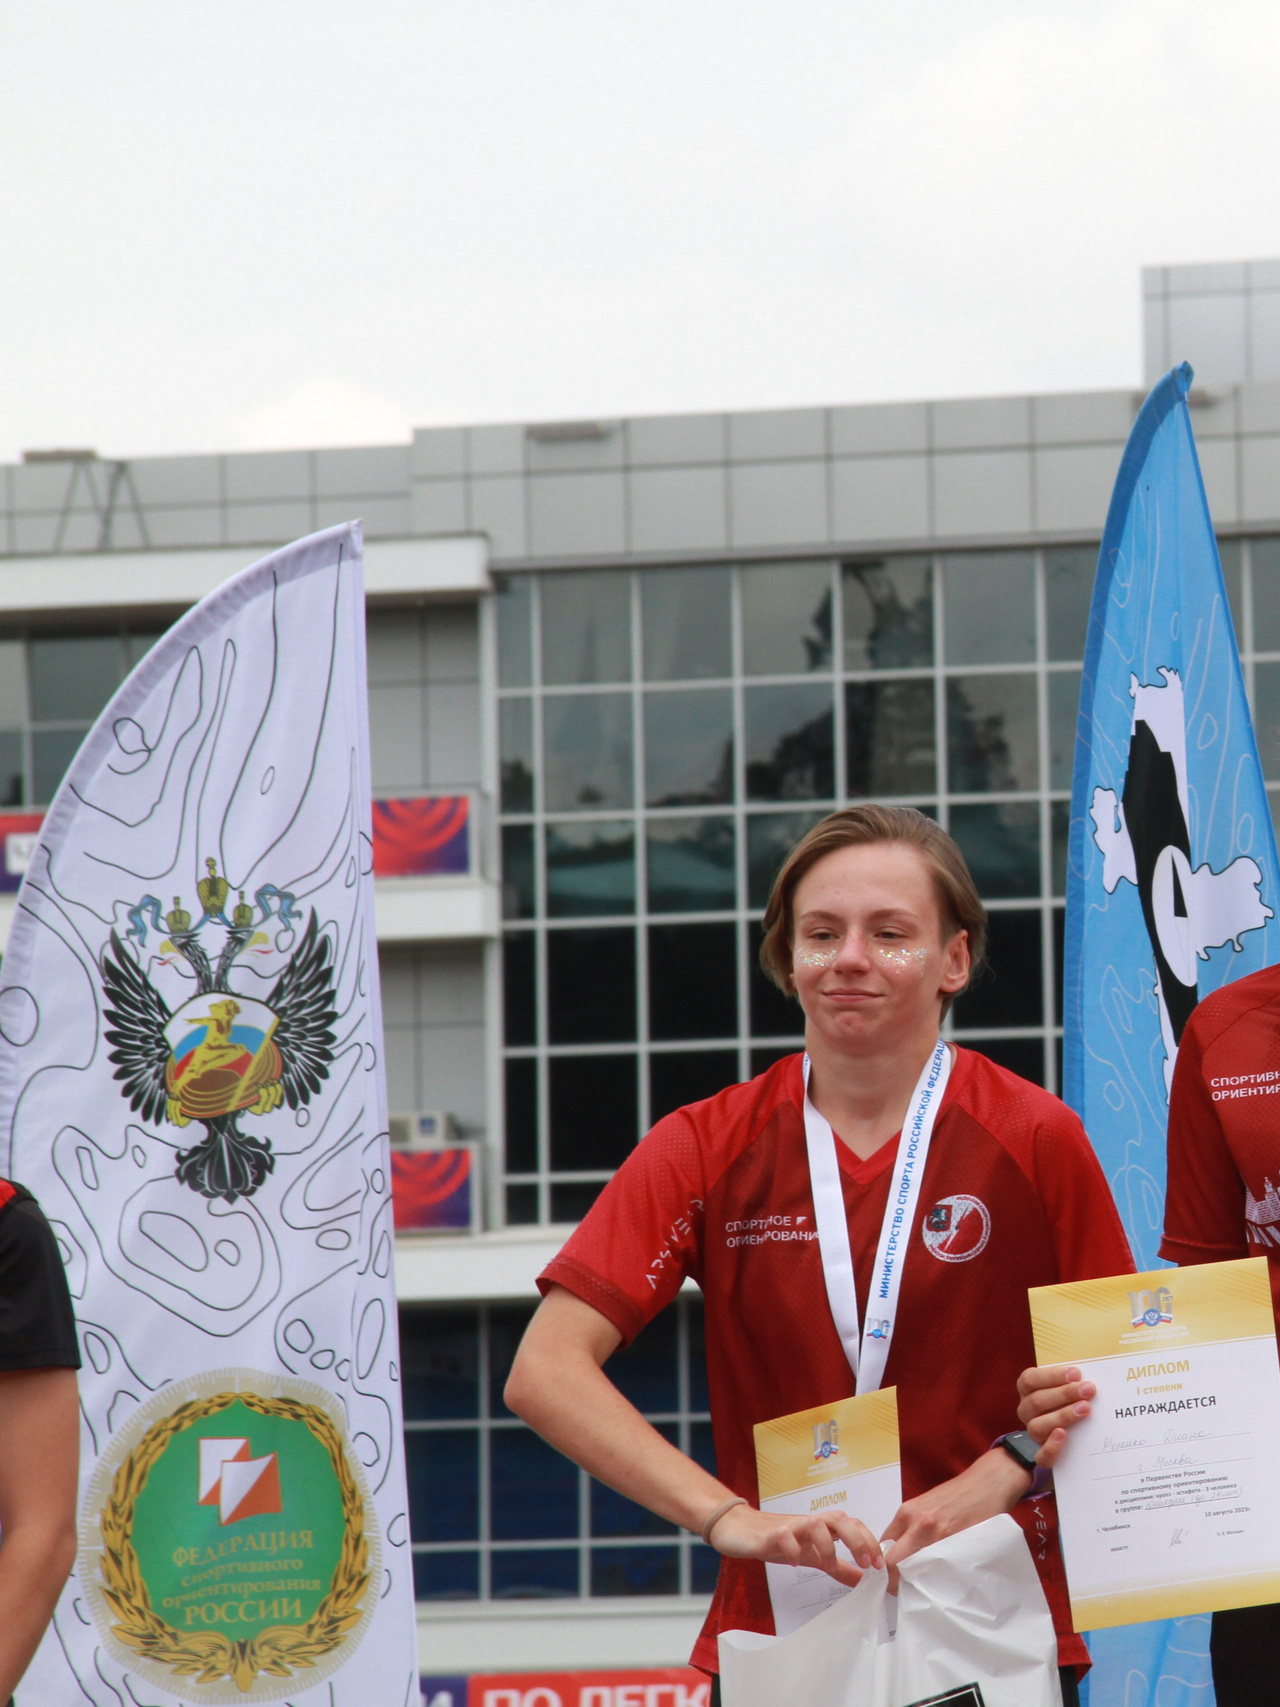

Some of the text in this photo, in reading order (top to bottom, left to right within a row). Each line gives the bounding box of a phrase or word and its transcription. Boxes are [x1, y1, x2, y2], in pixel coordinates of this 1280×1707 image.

[879, 1208, 905, 1299] МИНИСТЕРСТВО
[897, 1161, 914, 1205] СПОРТА
[907, 1089, 933, 1159] РОССИЙСКОЙ
[1126, 1360, 1190, 1382] ДИПЛОМ
[1143, 1383, 1183, 1395] степени
[1115, 1395, 1217, 1419] НАГРАЖДАЕТСЯ
[1153, 1453, 1199, 1468] Москва
[1130, 1483, 1172, 1494] спортивному
[1173, 1475, 1229, 1488] ориентированию
[1146, 1472, 1182, 1482] Первенстве
[1183, 1469, 1206, 1477] России
[810, 1491, 847, 1512] ДИПЛОМ
[1119, 1494, 1154, 1505] дисциплине:
[1176, 1487, 1201, 1496] эстафета
[1210, 1483, 1237, 1491] человека
[1120, 1505, 1144, 1513] группе:
[1213, 1509, 1233, 1517] августа
[1102, 1523, 1131, 1532] Челябинск
[172, 1530, 314, 1567] ФЕДЕРАЦИЯ
[181, 1558, 303, 1587] спортивного
[161, 1579, 321, 1609] ориентирования
[185, 1597, 302, 1625] РОССИИ
